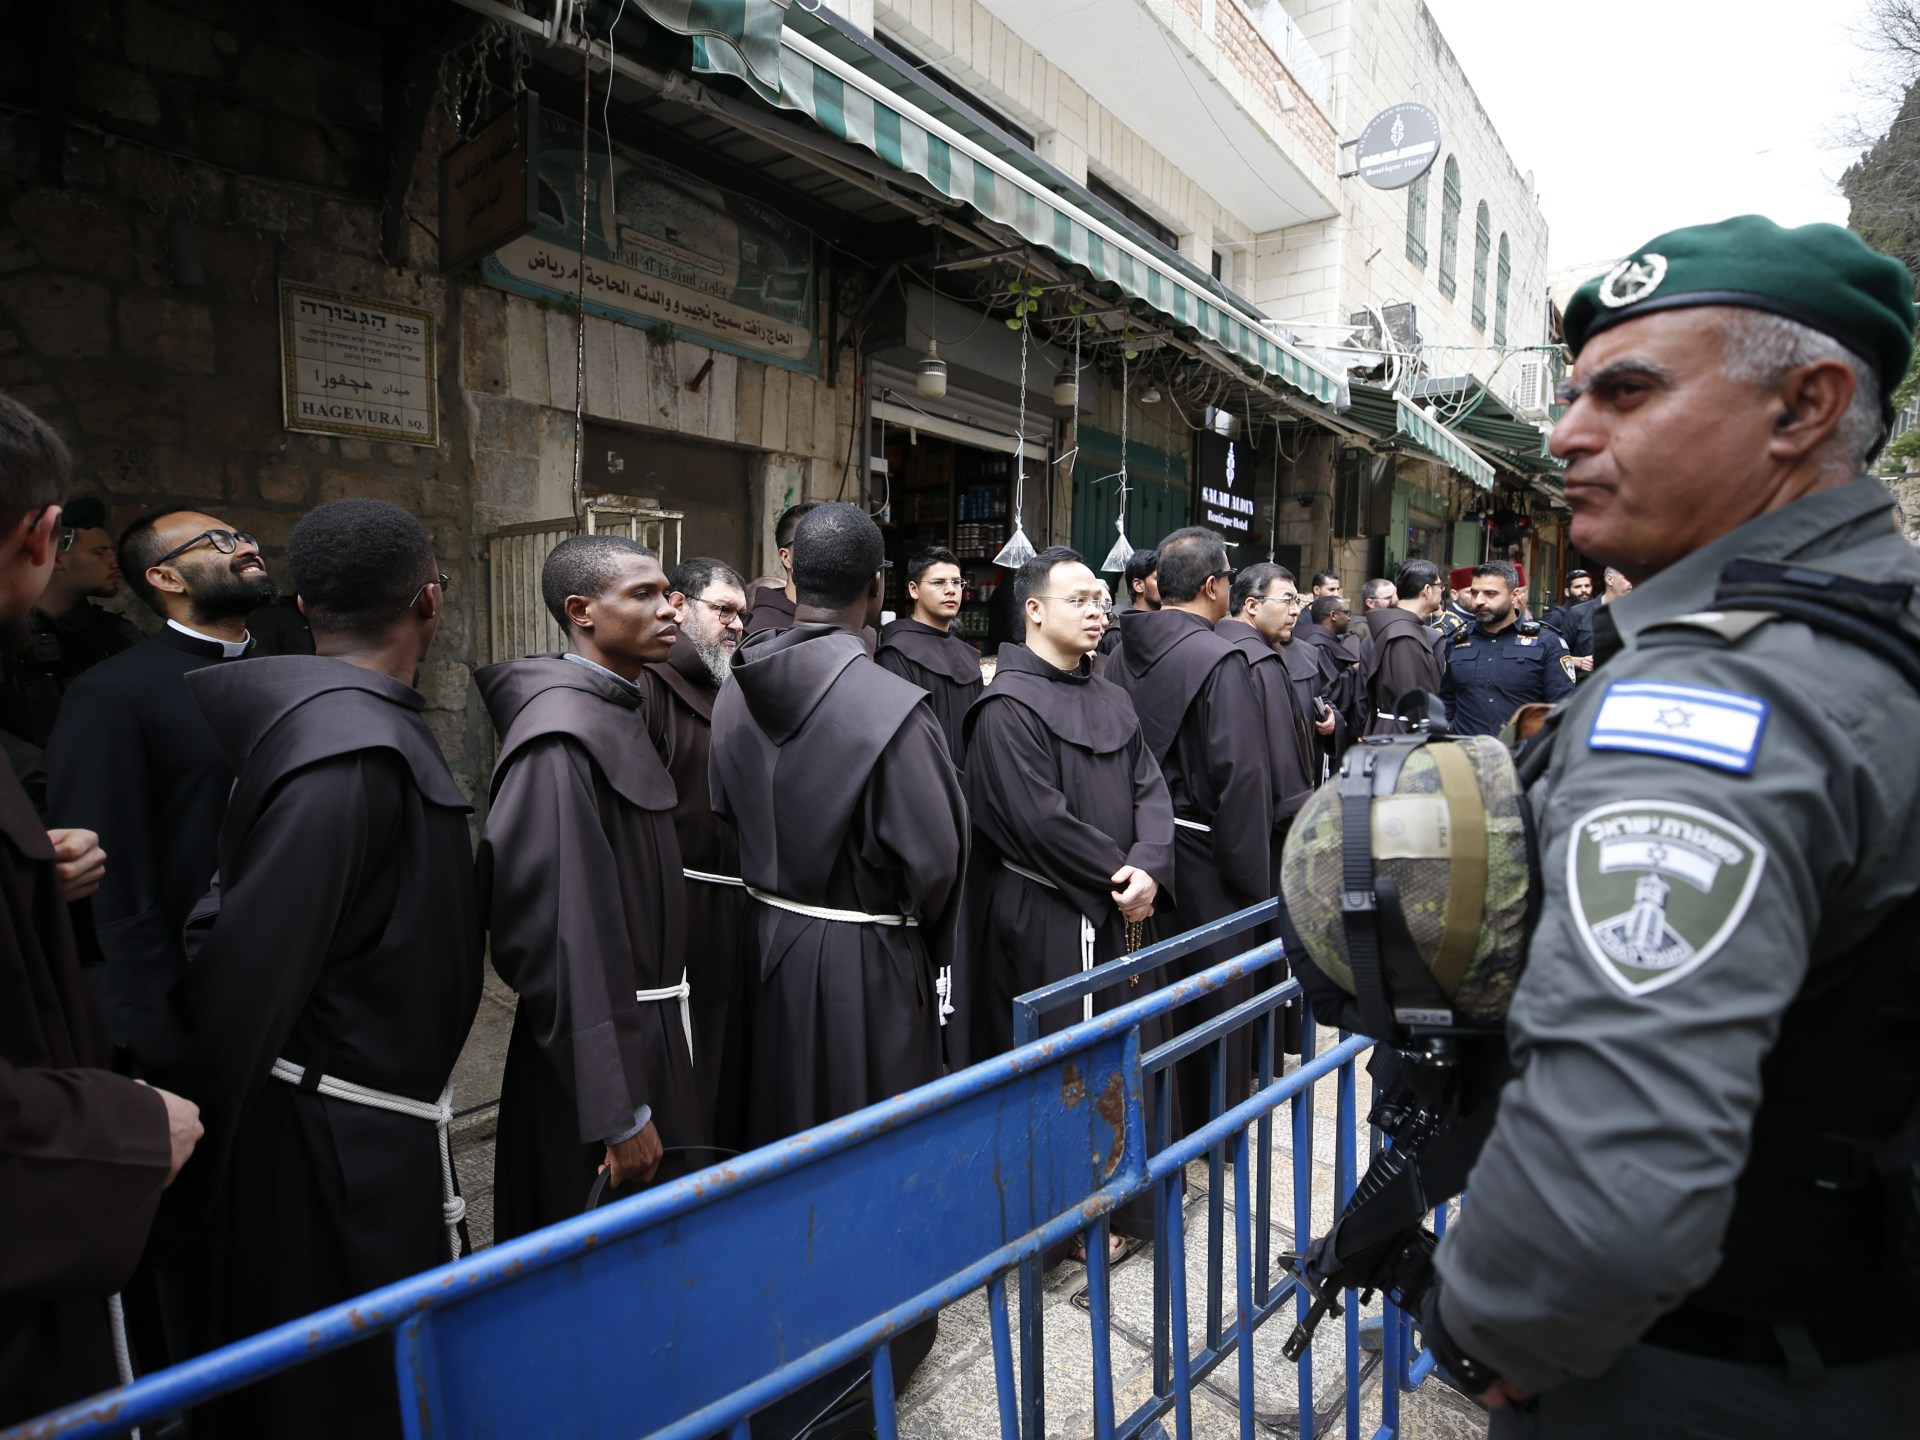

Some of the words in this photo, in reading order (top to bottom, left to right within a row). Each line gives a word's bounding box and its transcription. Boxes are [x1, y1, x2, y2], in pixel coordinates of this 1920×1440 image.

[1366, 163, 1402, 176] Boutique
[1404, 155, 1427, 168] Hotel
[528, 251, 565, 278] رياض
[584, 265, 630, 296] الحاجة
[681, 302, 710, 322] نجيب
[712, 309, 742, 330] سميح
[743, 319, 766, 341] رأفت
[767, 328, 793, 346] الحاج
[382, 384, 410, 396] ميدان
[302, 401, 401, 426] HAGEVURA
[407, 418, 425, 430] SQ.
[1202, 486, 1230, 509] SALAH
[1207, 509, 1233, 528] Boutique
[1233, 517, 1248, 531] Hotel
[1586, 814, 1661, 843] ישראל
[1661, 818, 1743, 865] משטרת
